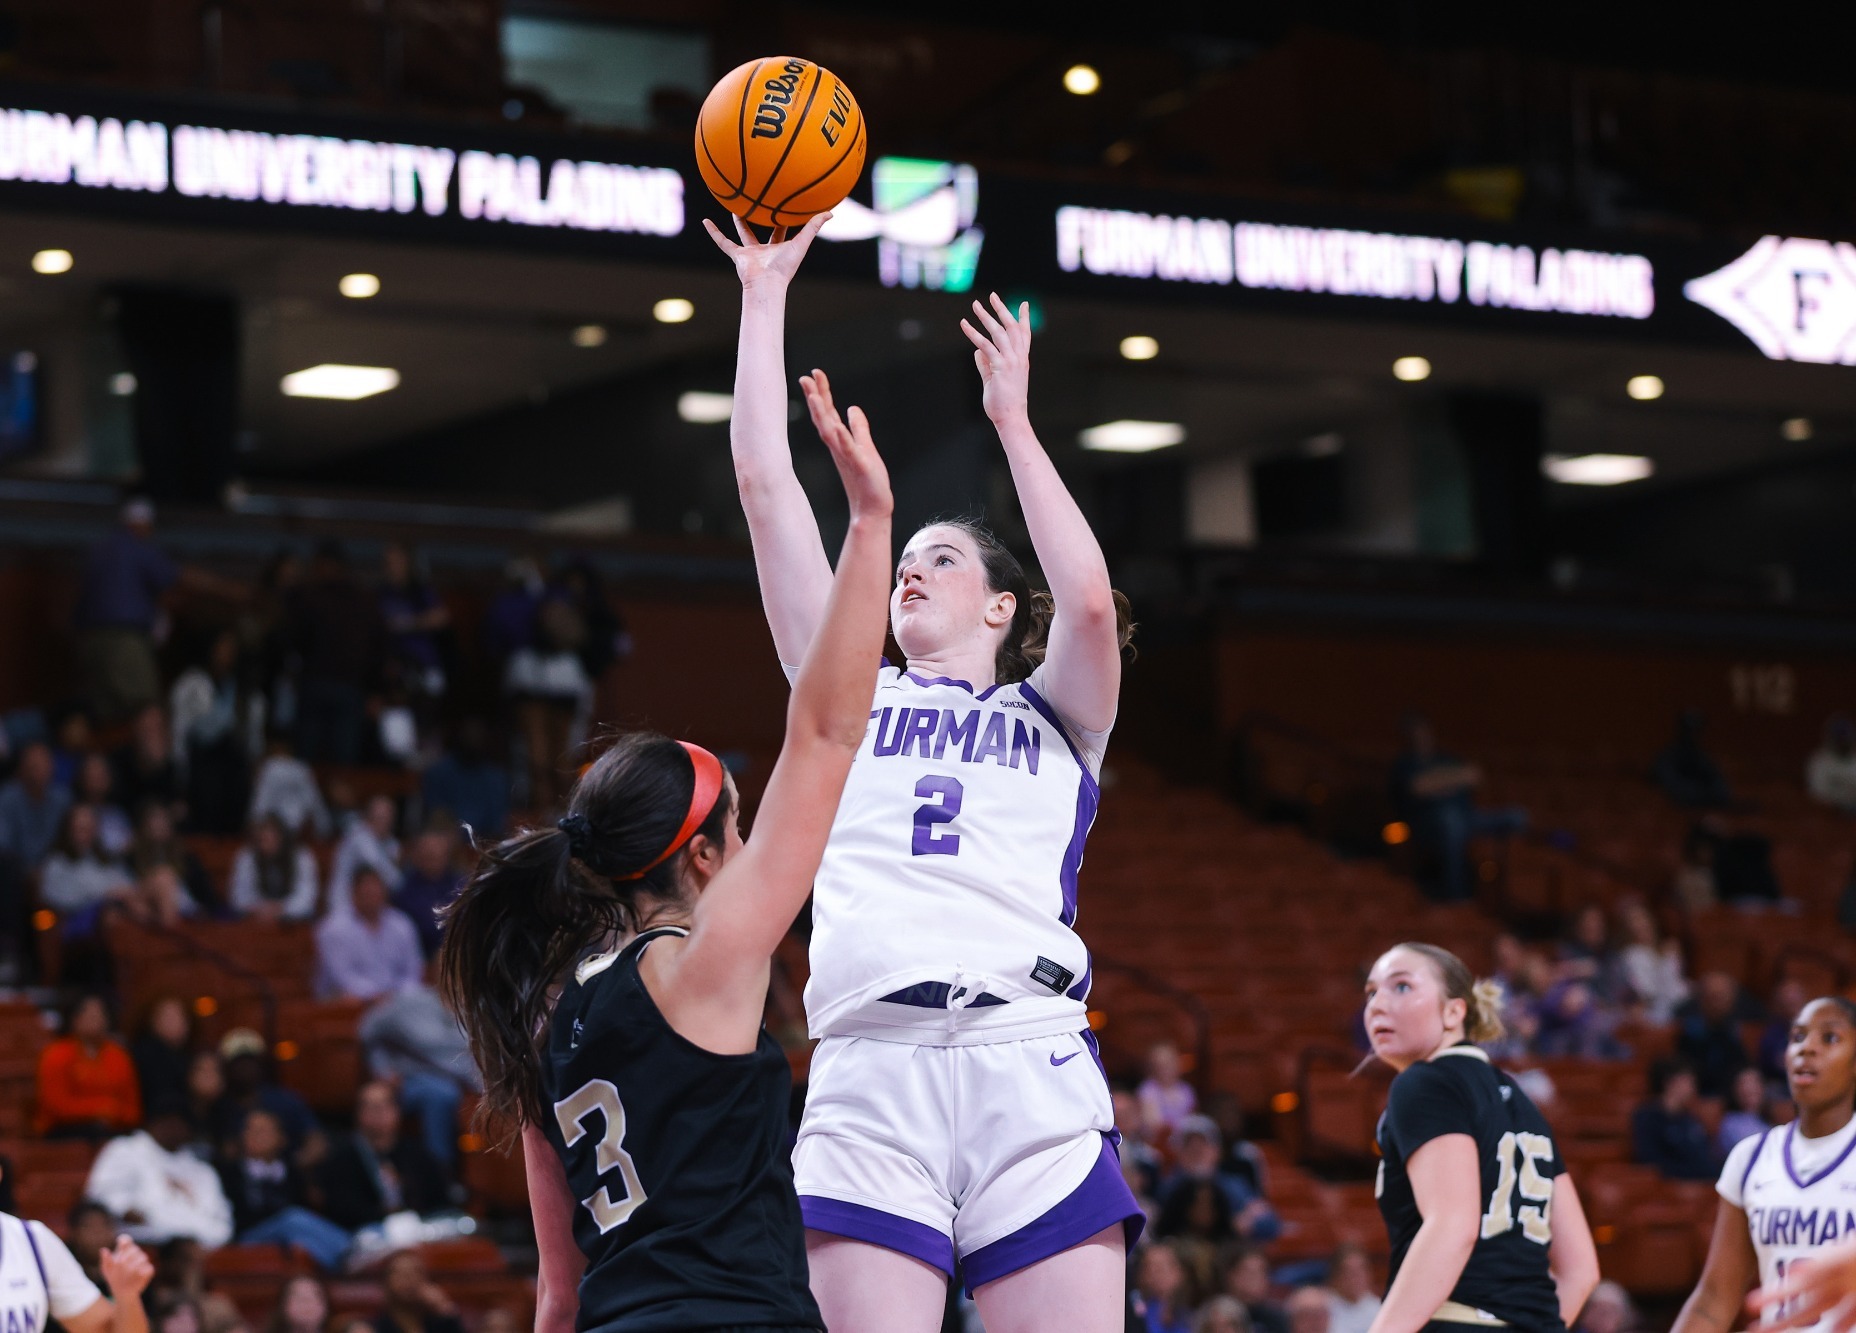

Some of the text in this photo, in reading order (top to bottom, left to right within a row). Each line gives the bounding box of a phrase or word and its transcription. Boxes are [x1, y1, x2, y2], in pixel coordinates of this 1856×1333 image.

[172, 124, 455, 216] UNIVERSITY
[458, 150, 684, 237] PALADINS
[1056, 205, 1654, 319] FURMAN UNIVERSITY PALADINS
[1793, 270, 1832, 332] F
[1000, 701, 1030, 711] SOCON
[912, 775, 964, 856] 2
[554, 1078, 648, 1235] 3
[1480, 1131, 1554, 1246] 15
